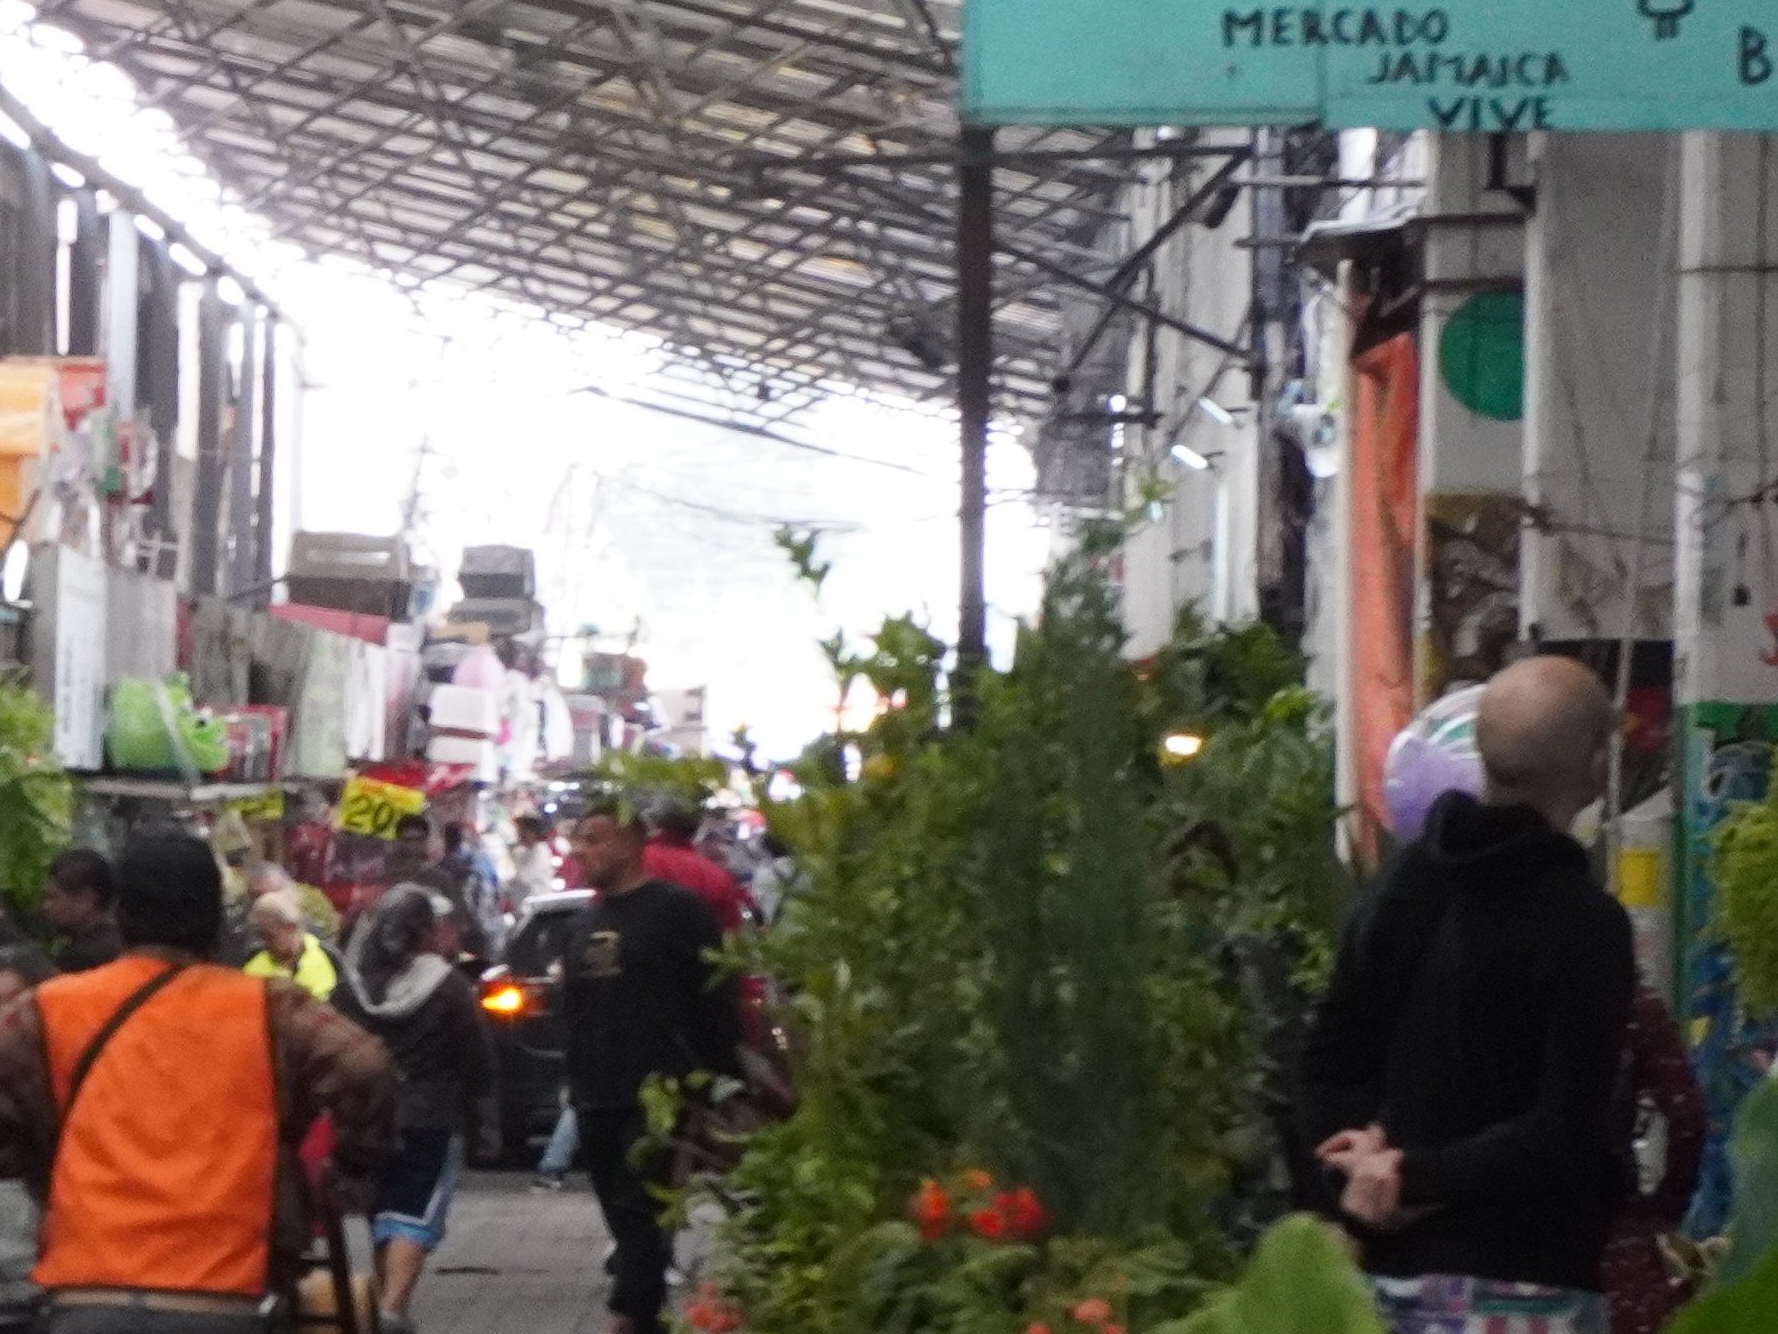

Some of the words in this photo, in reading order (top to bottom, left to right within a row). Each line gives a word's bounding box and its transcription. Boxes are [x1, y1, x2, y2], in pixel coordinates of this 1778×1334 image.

[1221, 7, 1450, 49] MERCADO
[1366, 49, 1571, 88] JAMAICA
[1425, 94, 1556, 131] VIVE
